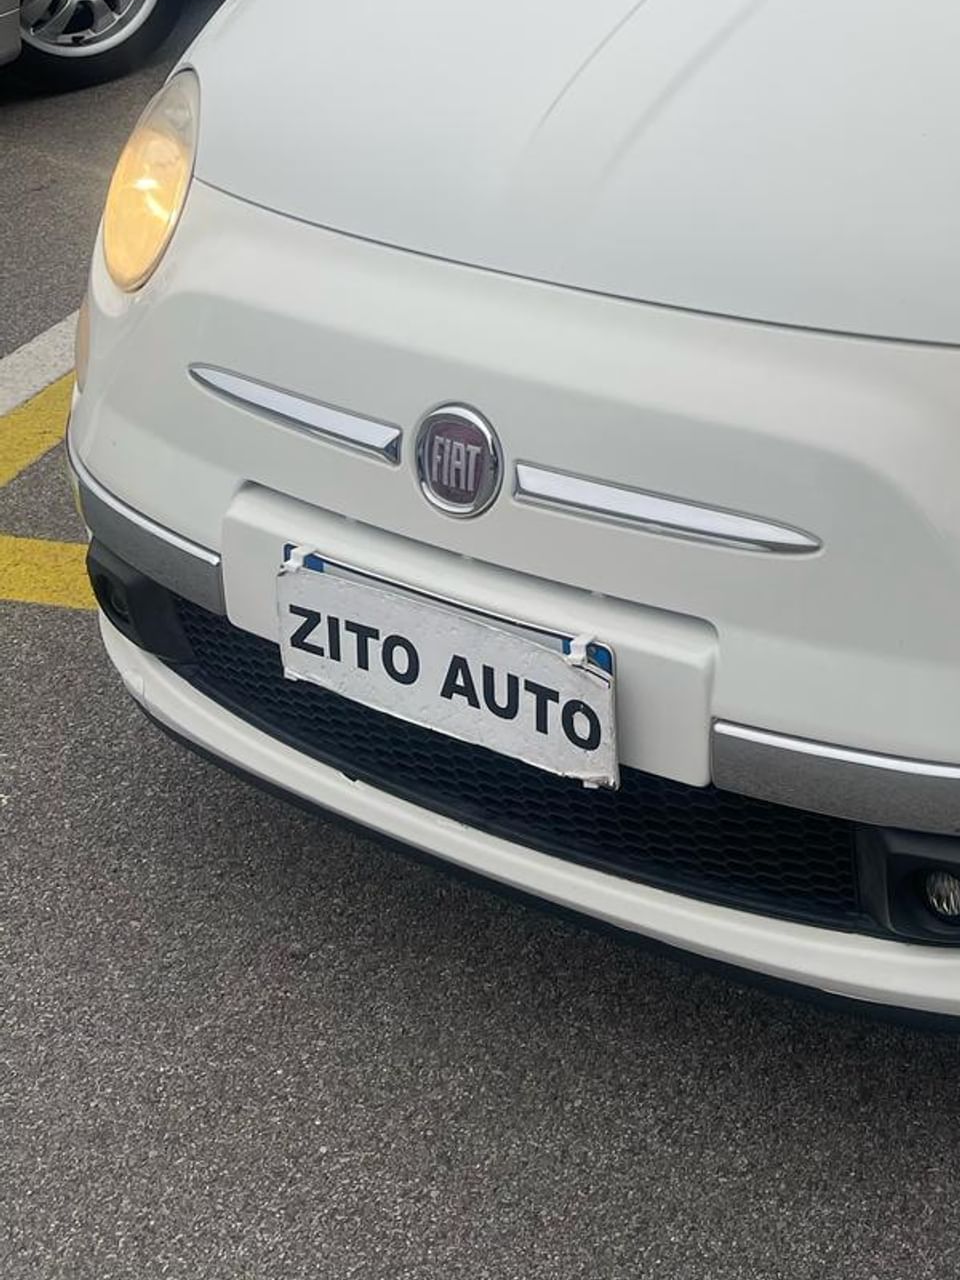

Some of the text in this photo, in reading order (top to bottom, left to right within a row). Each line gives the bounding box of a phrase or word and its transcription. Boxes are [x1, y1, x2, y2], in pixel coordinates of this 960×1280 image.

[432, 436, 482, 491] FIAT
[289, 604, 601, 751] ZITO AUTO
